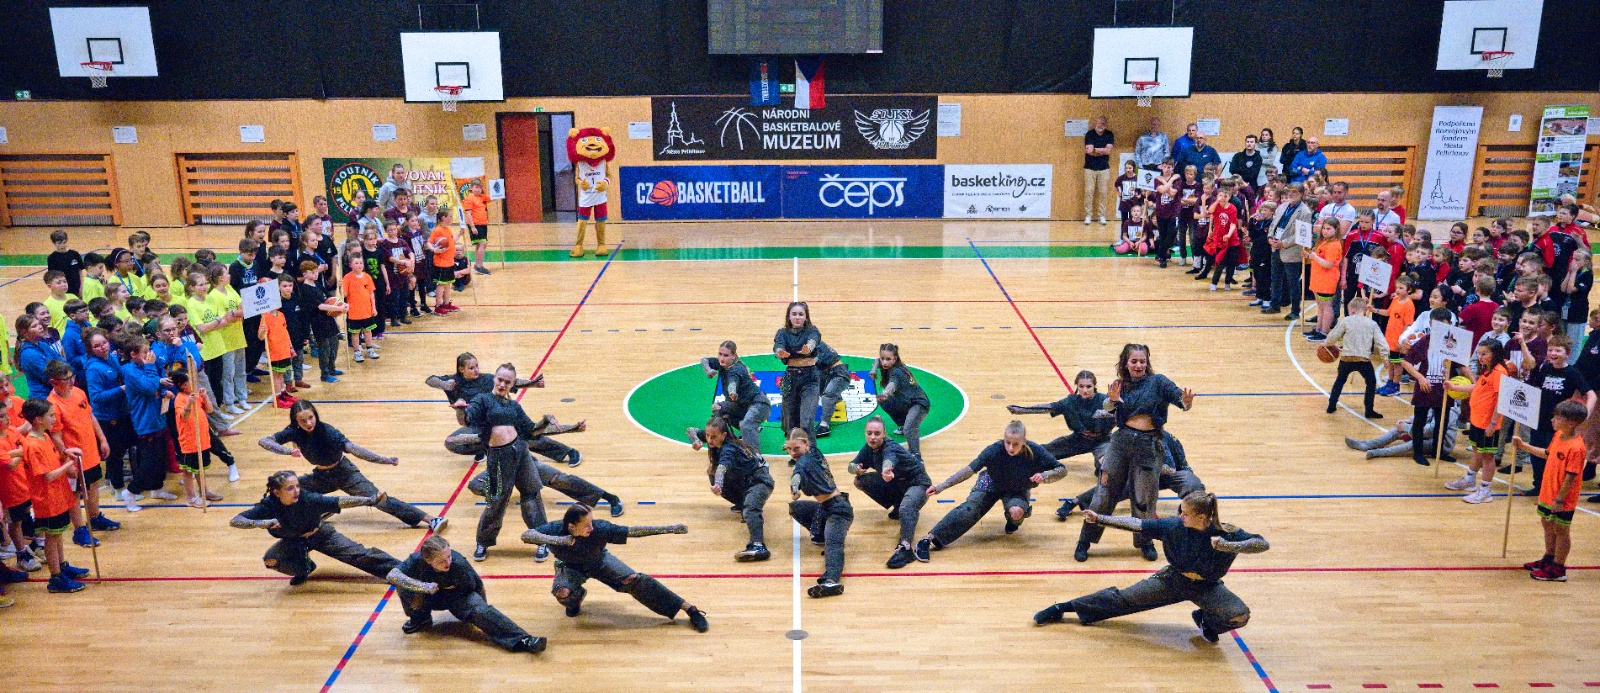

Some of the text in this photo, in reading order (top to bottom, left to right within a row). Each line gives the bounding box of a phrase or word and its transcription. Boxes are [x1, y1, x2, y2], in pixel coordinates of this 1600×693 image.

[762, 120, 841, 132] BASKETBALOVÉ
[763, 134, 841, 150] MUZEUM
[636, 181, 765, 204] CZ BASKETBALL
[952, 172, 1046, 198] basketking.cz
